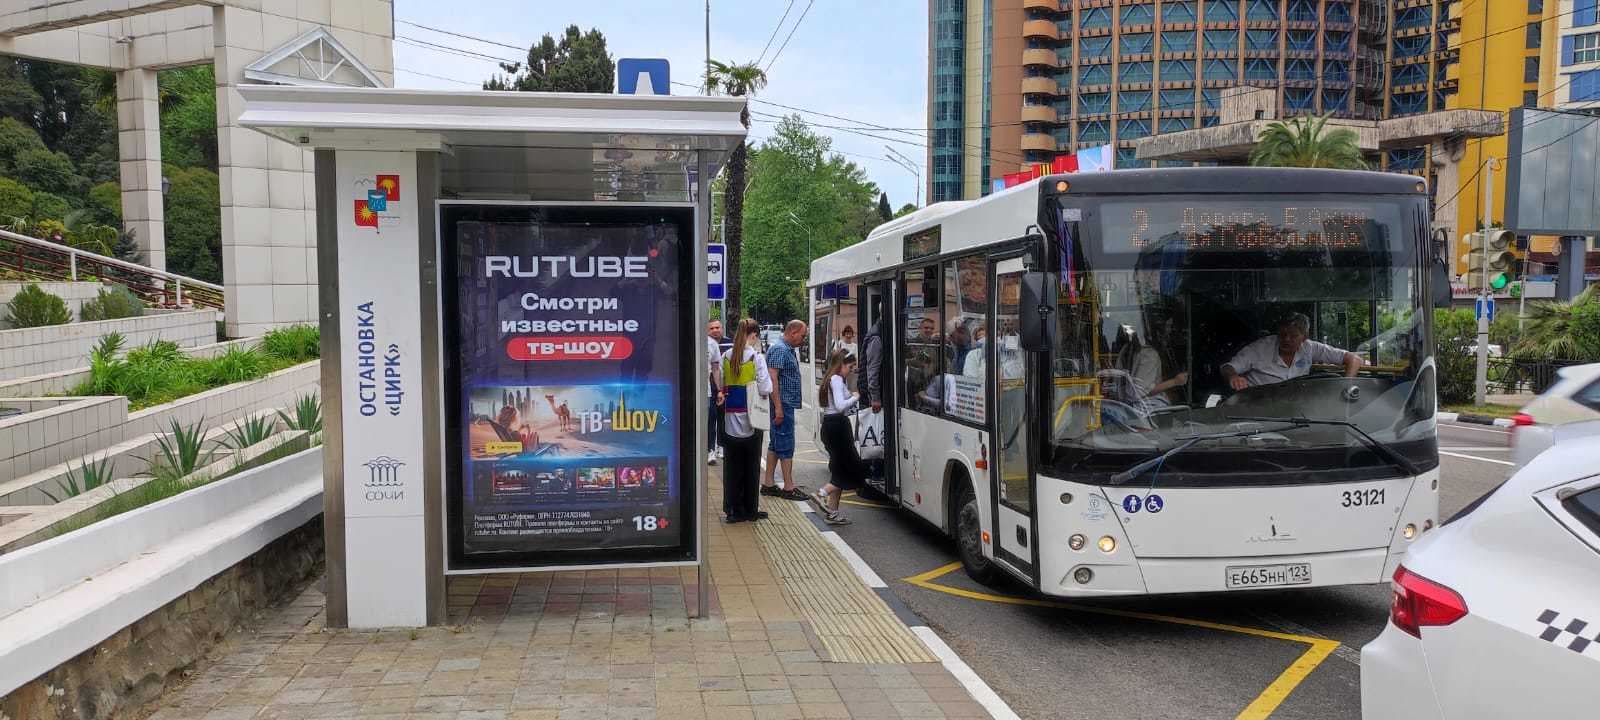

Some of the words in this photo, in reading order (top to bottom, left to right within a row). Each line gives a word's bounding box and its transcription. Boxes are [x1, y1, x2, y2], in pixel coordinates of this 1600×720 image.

[1131, 208, 1150, 248] 2
[485, 256, 649, 278] RUTUBE
[520, 293, 618, 314] Смотри
[501, 319, 639, 333] известные
[357, 300, 377, 416] ОСТАНОВКА
[526, 342, 615, 359] тв-шоу
[384, 343, 404, 416] «ЦИРК»
[365, 491, 404, 501] СОЧИ
[1341, 488, 1385, 507] 33121
[632, 515, 669, 531] 18+
[1288, 565, 1309, 577] 123
